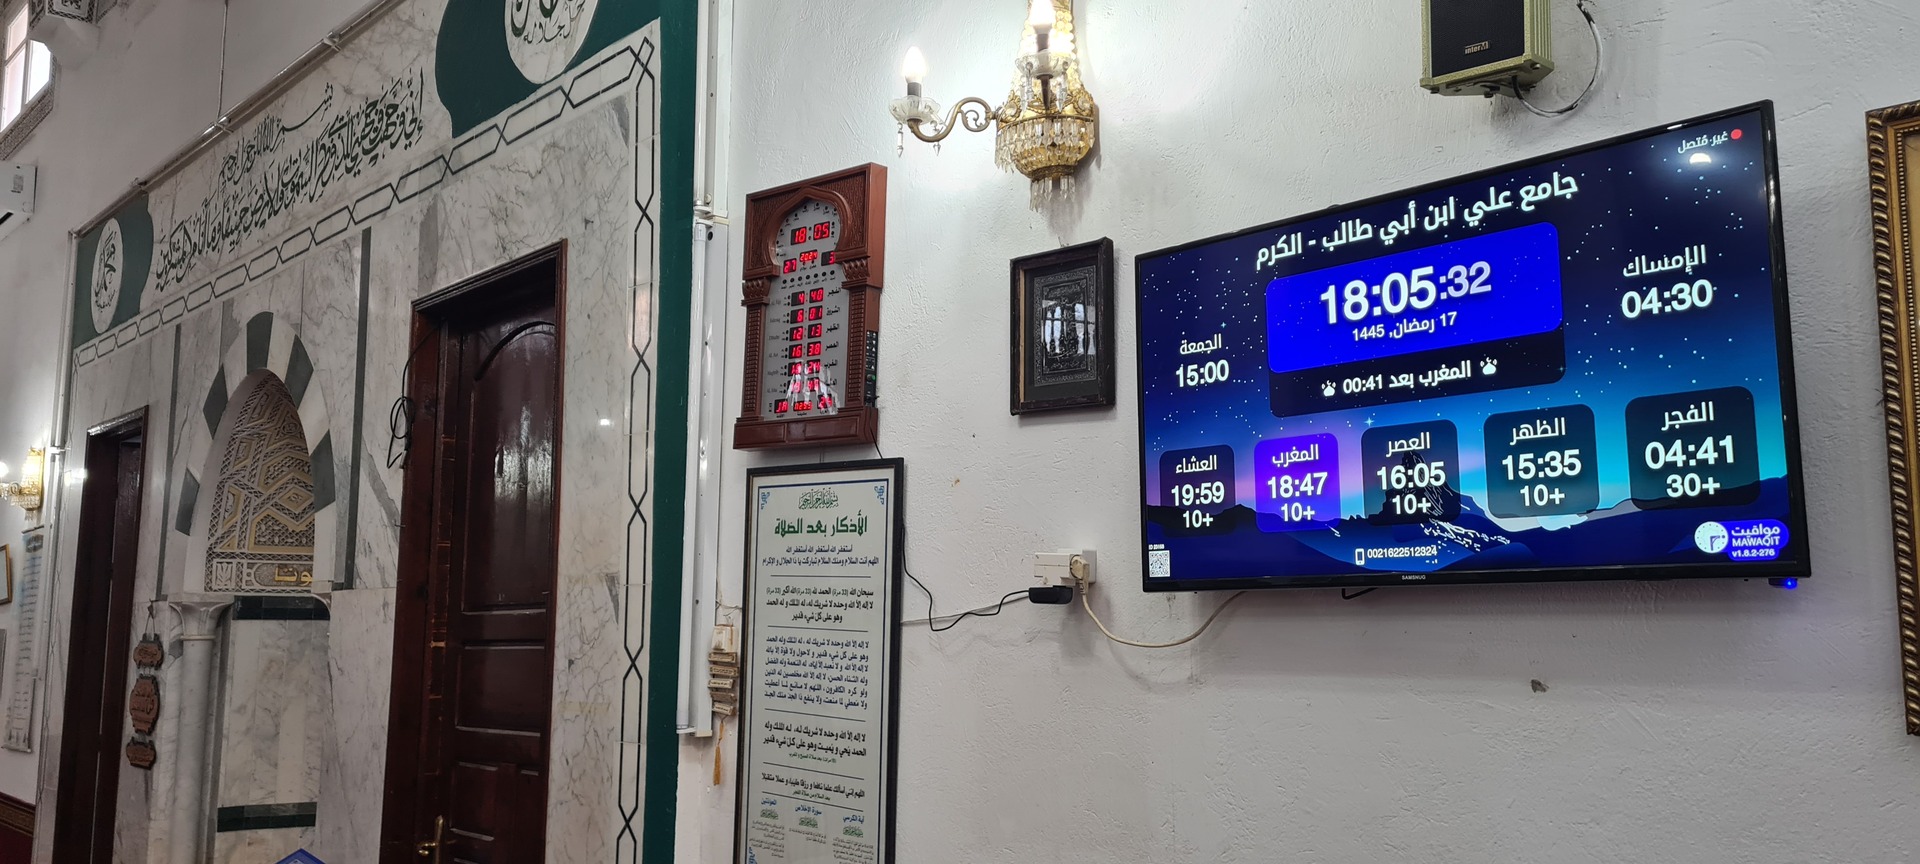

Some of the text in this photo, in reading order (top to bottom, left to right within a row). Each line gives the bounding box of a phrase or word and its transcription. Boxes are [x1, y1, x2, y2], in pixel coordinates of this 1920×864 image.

[1710, 130, 1729, 147] غير
[1256, 171, 1578, 270] جامع علي ابن أبي طالب الكرم
[794, 222, 830, 243] 18:05
[783, 259, 796, 274] 27
[800, 251, 818, 261] 2024
[1622, 244, 1707, 277] الإمساك
[1320, 260, 1492, 325] 18:05:32
[1621, 278, 1713, 319] 04:30
[1440, 311, 1458, 327] 17
[1179, 333, 1222, 355] الجمعة
[1352, 324, 1385, 341] 1445
[1175, 359, 1230, 387] 15:00
[1342, 359, 1472, 394] المغرب بعد 00:41
[1661, 400, 1715, 431] الفجر
[1509, 417, 1566, 446] الظهر
[1386, 431, 1431, 457] العصر
[1644, 434, 1735, 470] 04:41
[1175, 455, 1217, 474] العشاء
[1271, 444, 1319, 468] المغرب
[1501, 448, 1582, 480] 15:35
[1267, 472, 1328, 499] 18:47
[1376, 461, 1446, 491] 16:05
[1666, 473, 1721, 498] 30+
[1171, 481, 1225, 507] 19:59
[1392, 493, 1431, 515] 10+
[1520, 484, 1566, 507] 10+
[831, 509, 867, 537] الأذكار
[1182, 509, 1214, 528] 10+
[1280, 502, 1316, 522] 10+
[806, 520, 827, 537] بعد
[1731, 523, 1780, 539] مواقيت
[792, 545, 807, 555] أستغفر
[814, 544, 830, 555] أستغفر
[837, 544, 853, 555] أستغفر
[1732, 536, 1781, 547] MAWAQIT
[1732, 549, 1775, 558] v1.8.2-276
